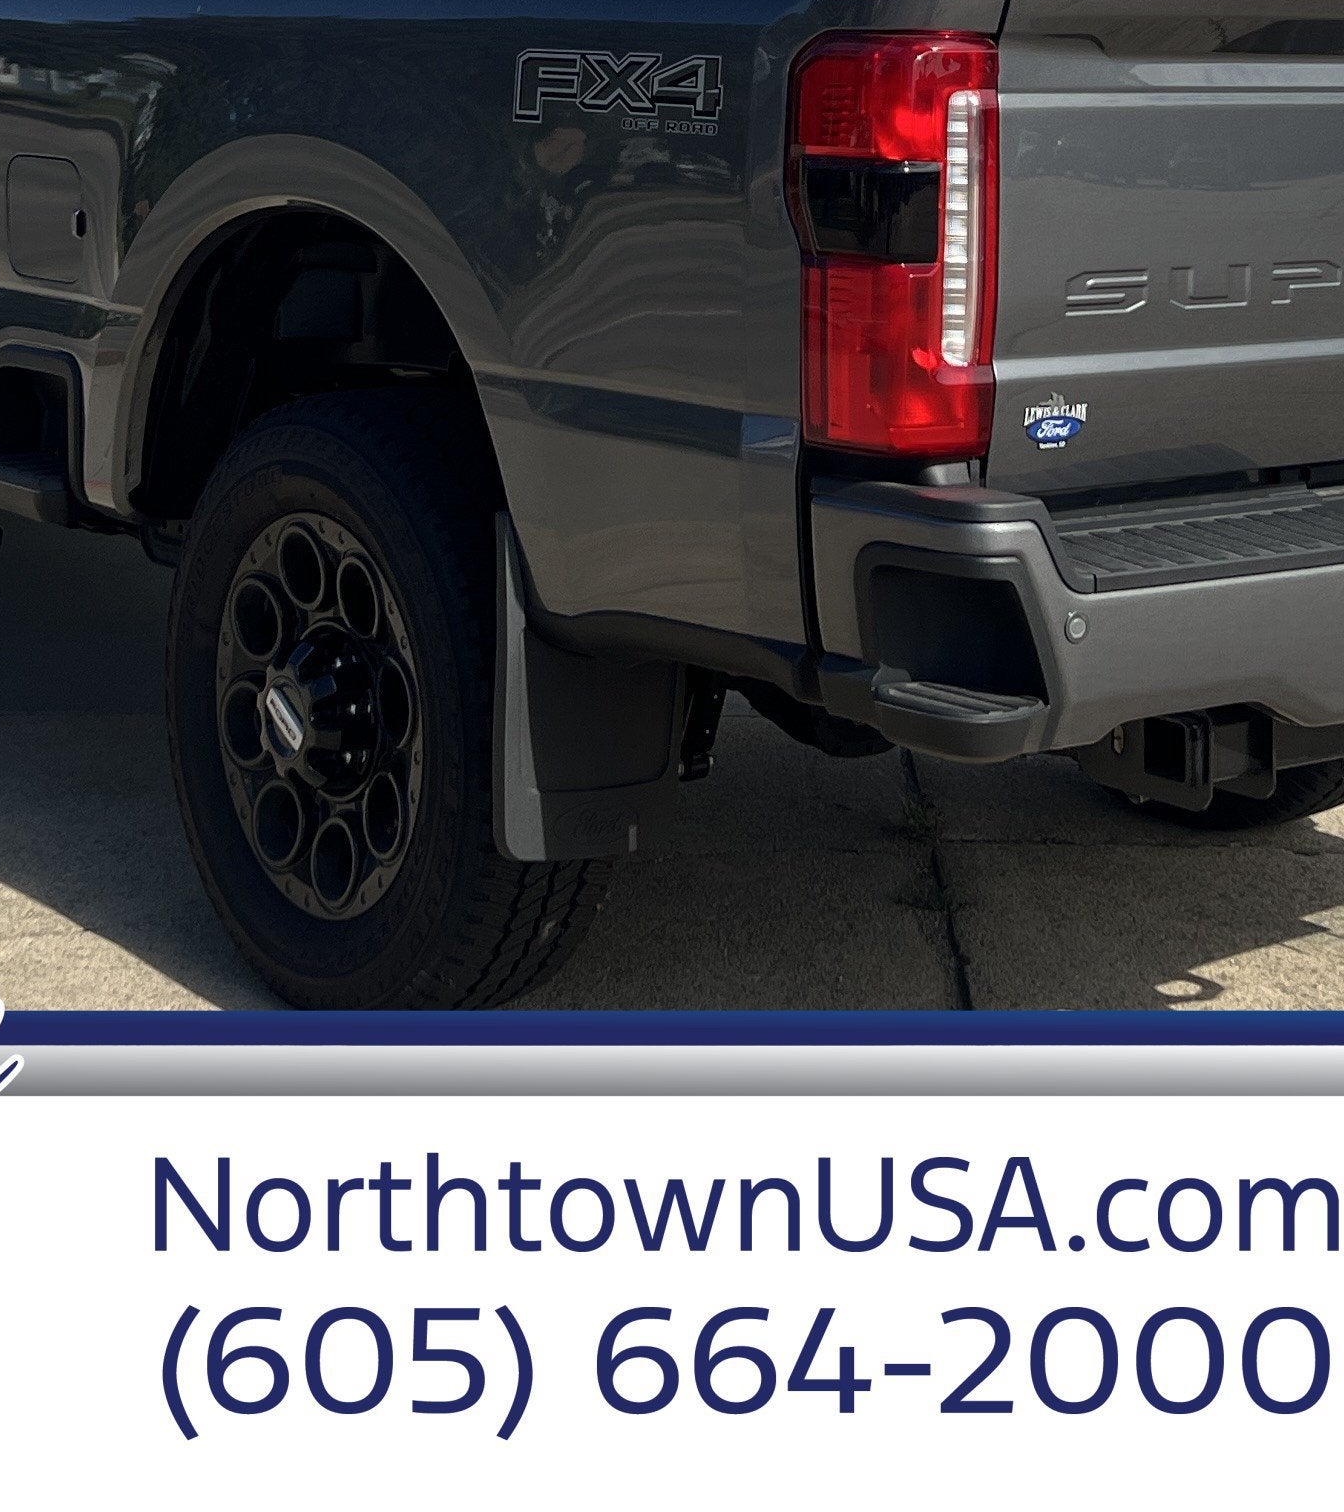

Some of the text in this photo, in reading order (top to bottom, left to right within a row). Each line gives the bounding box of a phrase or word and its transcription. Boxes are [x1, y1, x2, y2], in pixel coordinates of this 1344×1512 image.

[513, 48, 723, 124] FX4
[621, 117, 719, 136] OFF ROAD
[1023, 406, 1052, 427] LEWIS
[1060, 402, 1088, 422] CLARK
[1036, 419, 1072, 439] Ford
